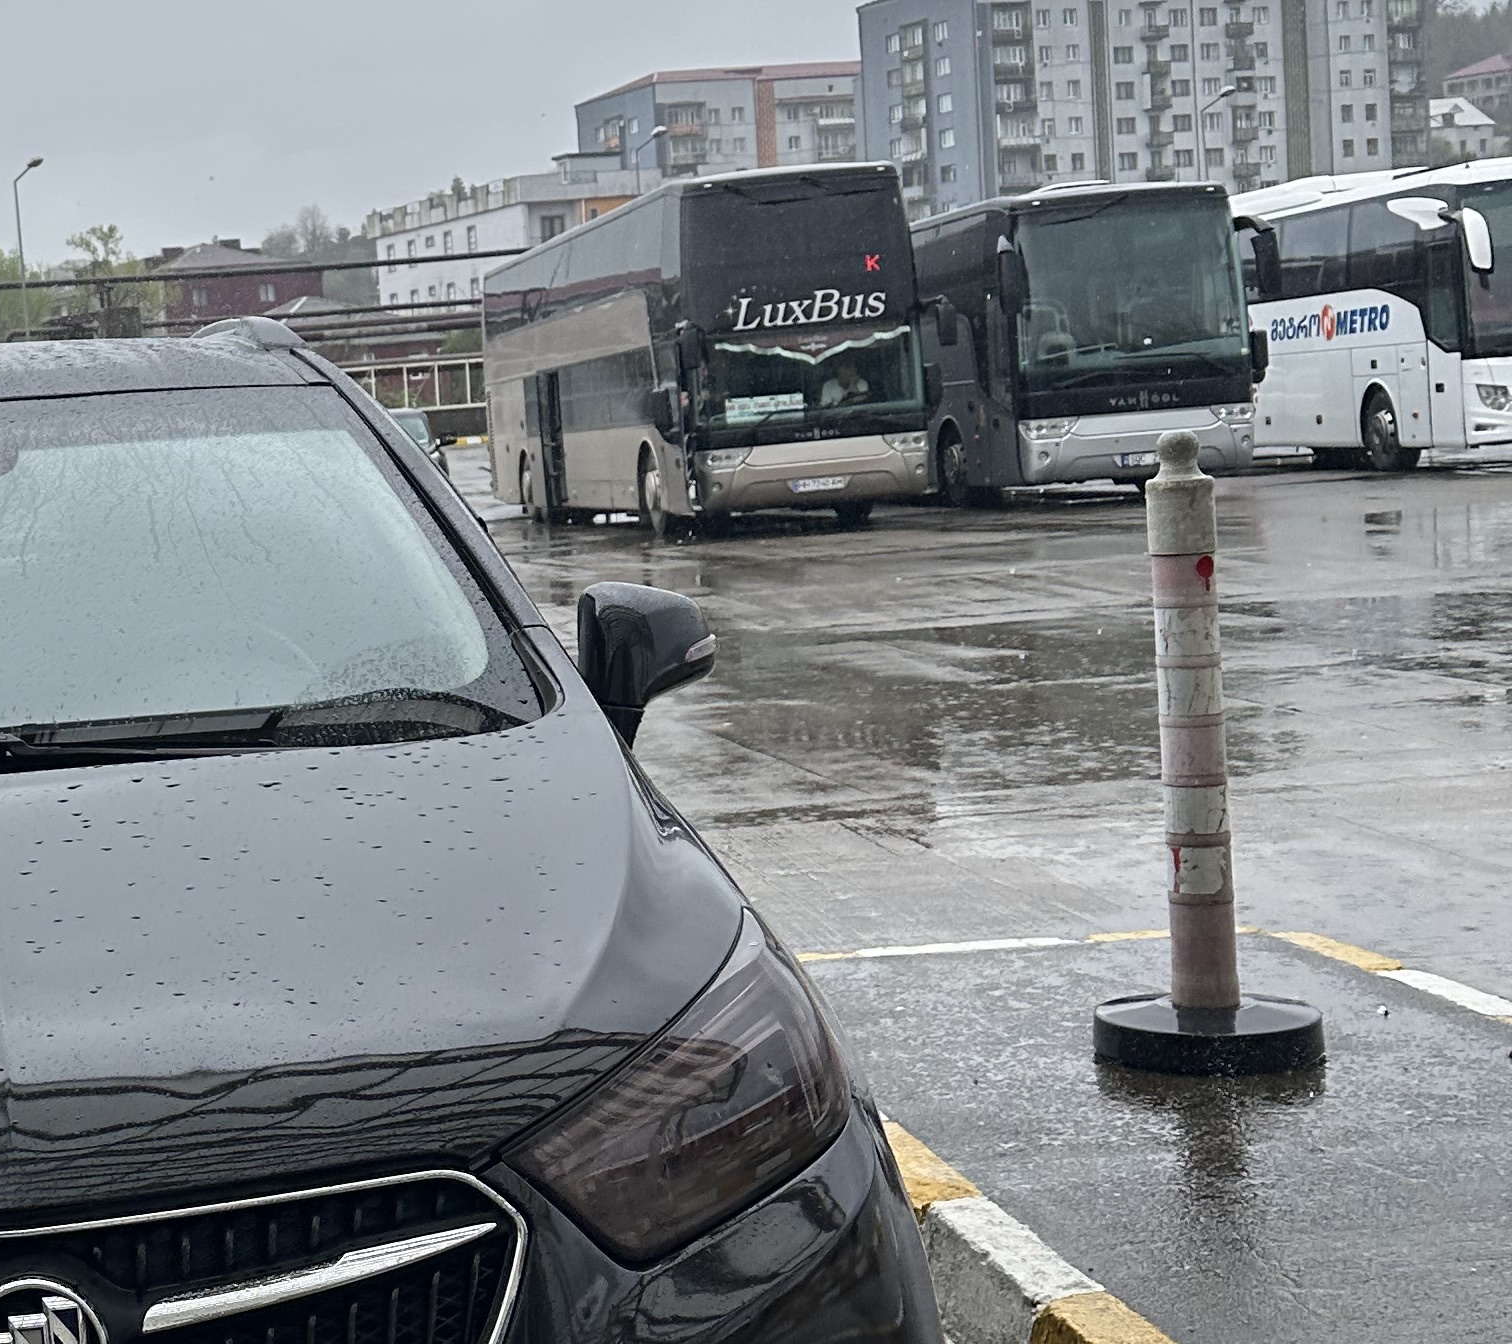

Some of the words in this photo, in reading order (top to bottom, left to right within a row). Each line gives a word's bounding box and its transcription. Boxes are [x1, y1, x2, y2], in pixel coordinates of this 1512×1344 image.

[733, 288, 887, 332] LuxBus
[1335, 304, 1391, 337] METRO
[1270, 314, 1321, 342] მეტრო
